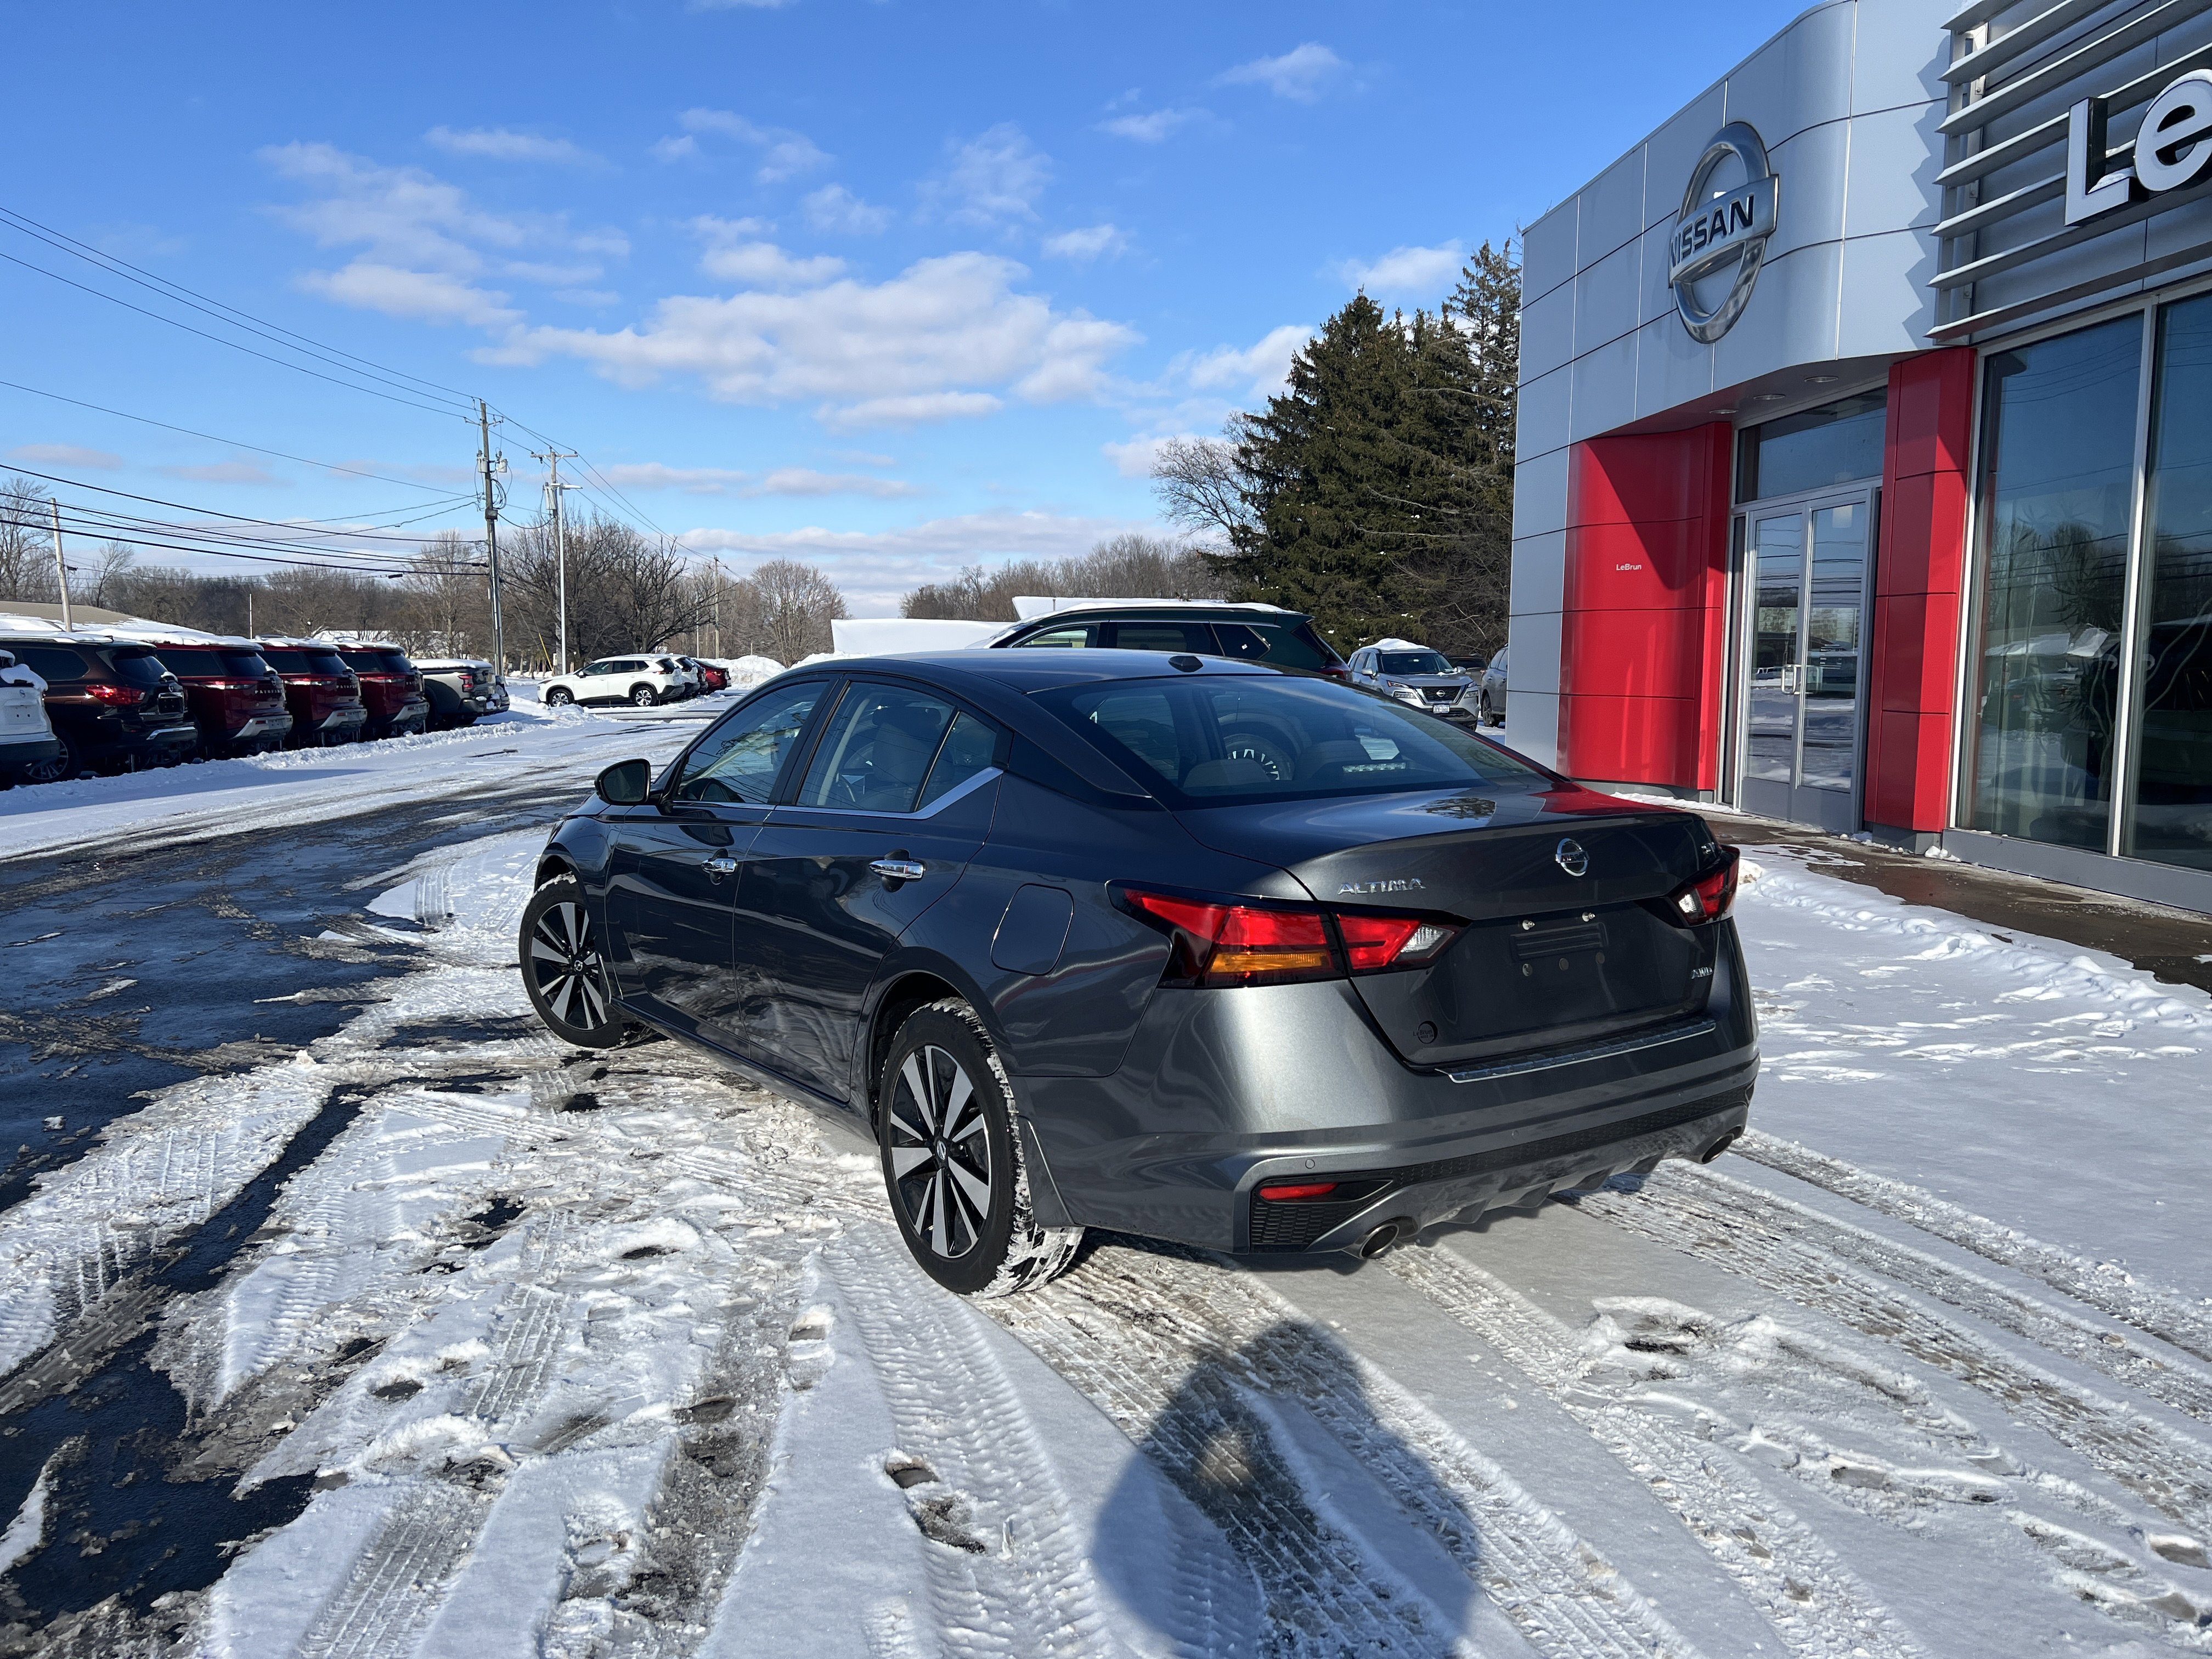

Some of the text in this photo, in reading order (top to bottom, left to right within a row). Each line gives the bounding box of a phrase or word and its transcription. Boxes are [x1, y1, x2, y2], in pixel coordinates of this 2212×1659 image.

[2065, 77, 2212, 227] Le
[1671, 195, 1754, 268] NISSAN
[1337, 878, 1427, 895] ALTIMA
